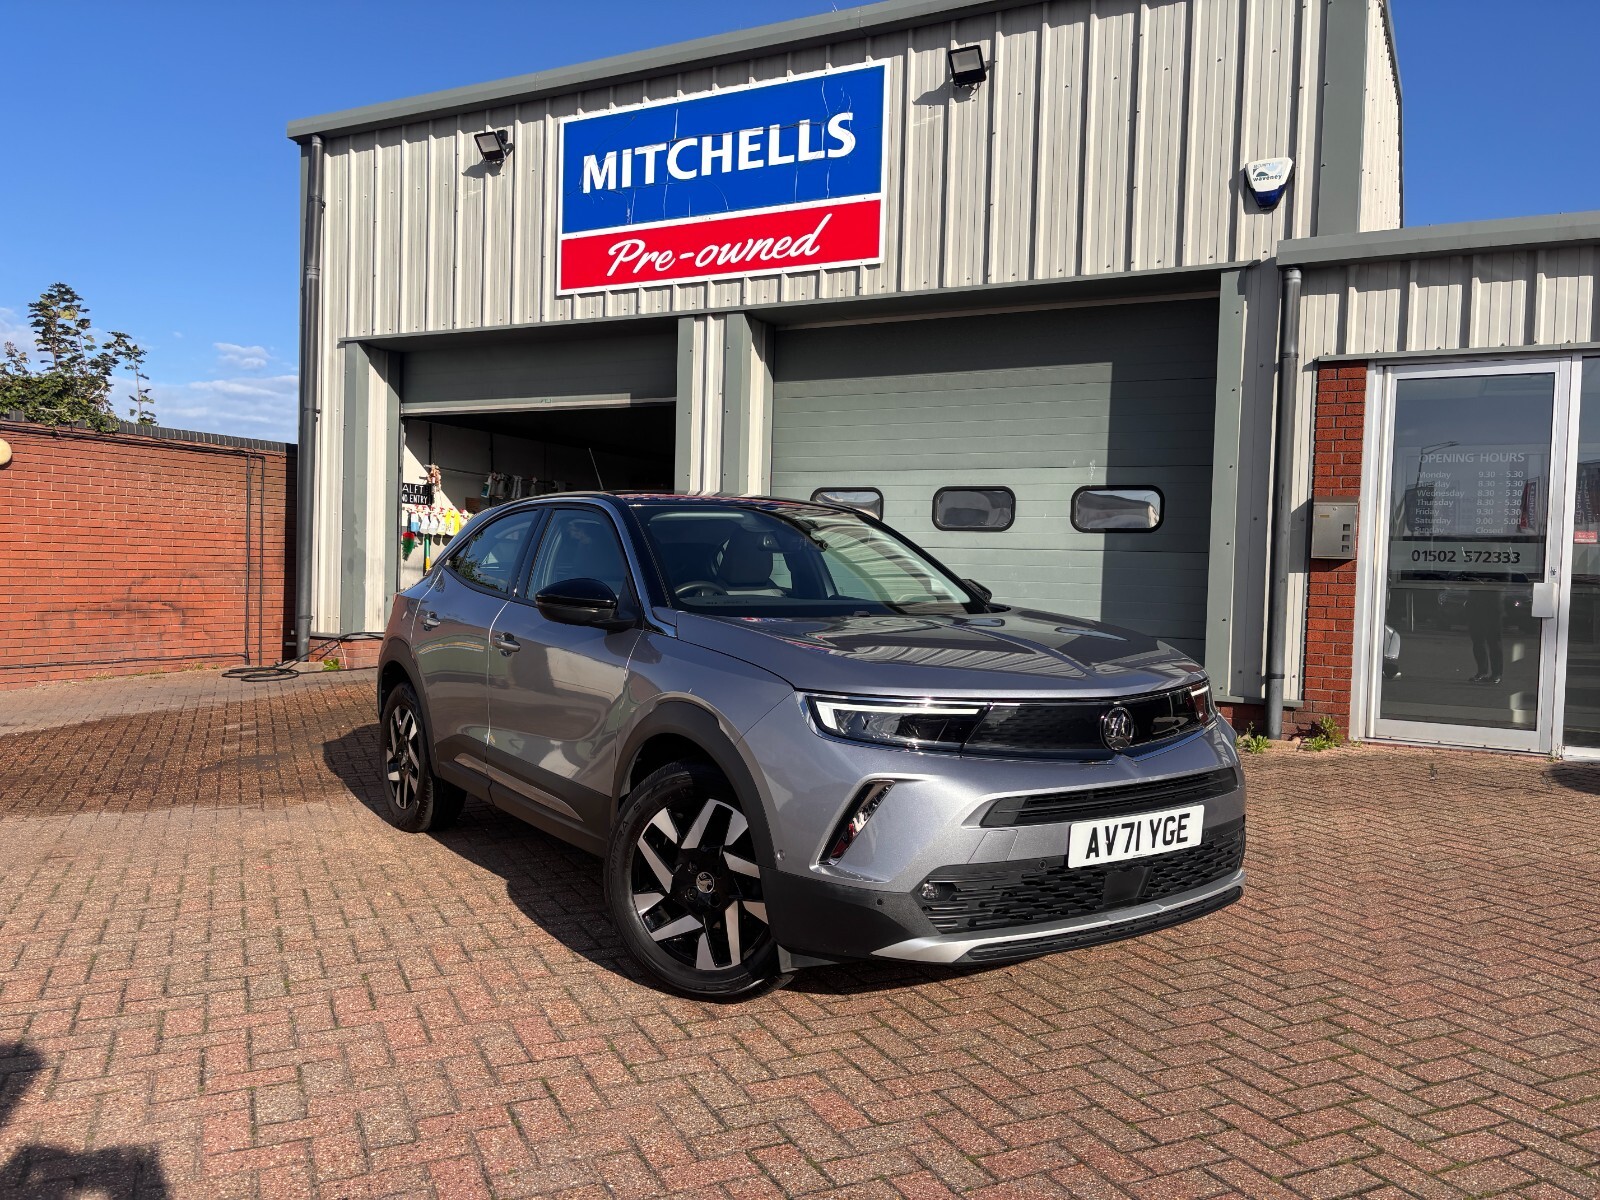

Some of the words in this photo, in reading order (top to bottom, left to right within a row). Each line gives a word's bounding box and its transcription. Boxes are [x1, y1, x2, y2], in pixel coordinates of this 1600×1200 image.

[582, 112, 856, 194] MITCHELLS
[1253, 174, 1282, 182] waveney
[606, 213, 833, 277] Pre-owned
[1418, 453, 1474, 464] OPENING
[1480, 452, 1525, 463] HOURS
[1418, 471, 1451, 479] Monday
[1506, 470, 1524, 478] 5.30
[1418, 480, 1451, 489] Tuesday
[1416, 489, 1465, 498] Wednesday
[410, 494, 428, 504] ENTRY
[1416, 498, 1454, 507] Thursday
[1415, 508, 1440, 516] Friday
[1415, 517, 1451, 526] Saturday
[1414, 526, 1445, 535] Sunday
[1475, 526, 1504, 534] Closed
[1411, 550, 1456, 562] 01502
[1463, 551, 1521, 563] 572333
[1085, 820, 1142, 860] AV71
[1149, 813, 1191, 849] YGE
